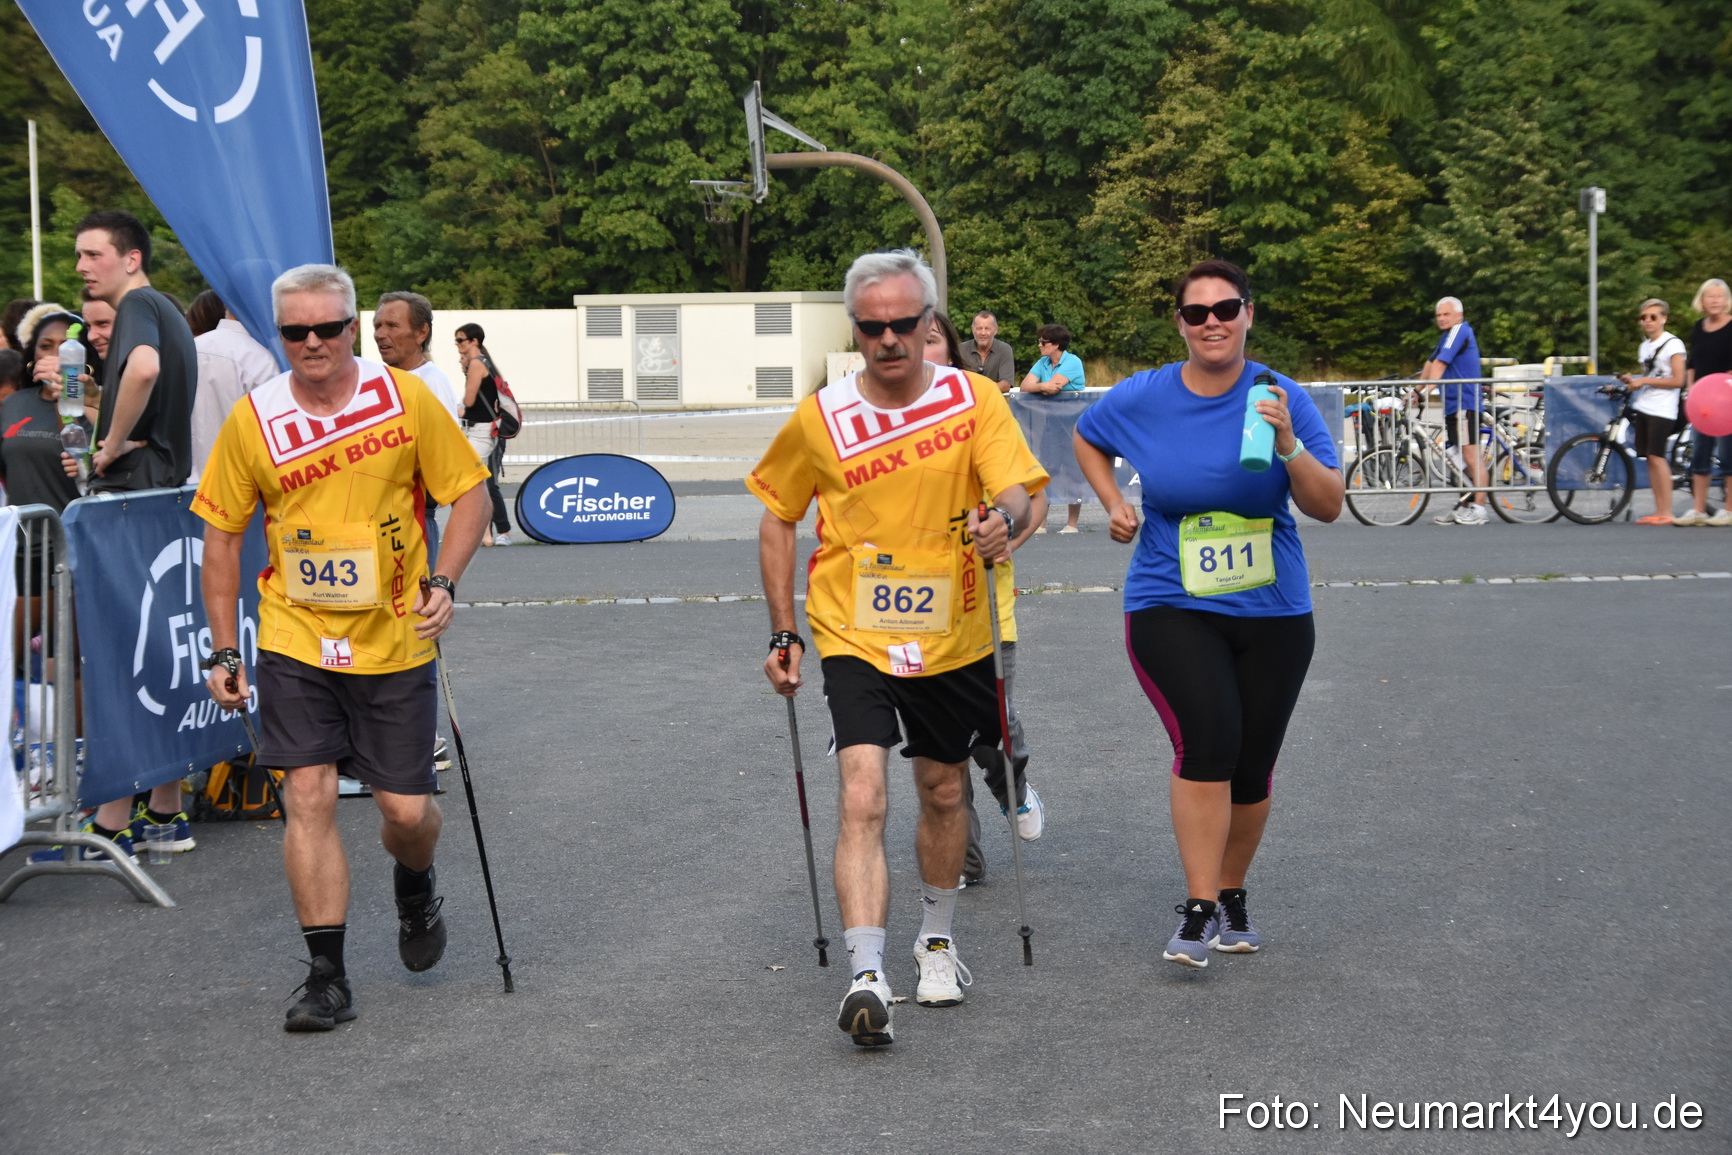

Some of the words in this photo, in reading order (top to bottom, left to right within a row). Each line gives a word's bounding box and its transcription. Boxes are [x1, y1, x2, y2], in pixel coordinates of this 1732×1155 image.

[279, 455, 341, 494] MAX
[345, 426, 413, 464] BÖGL
[844, 449, 908, 489] MAX
[562, 492, 656, 513] Fischer
[573, 512, 650, 523] AUTOMOBILE
[1199, 541, 1254, 573] 811
[299, 559, 359, 587] 943
[872, 584, 934, 613] 862
